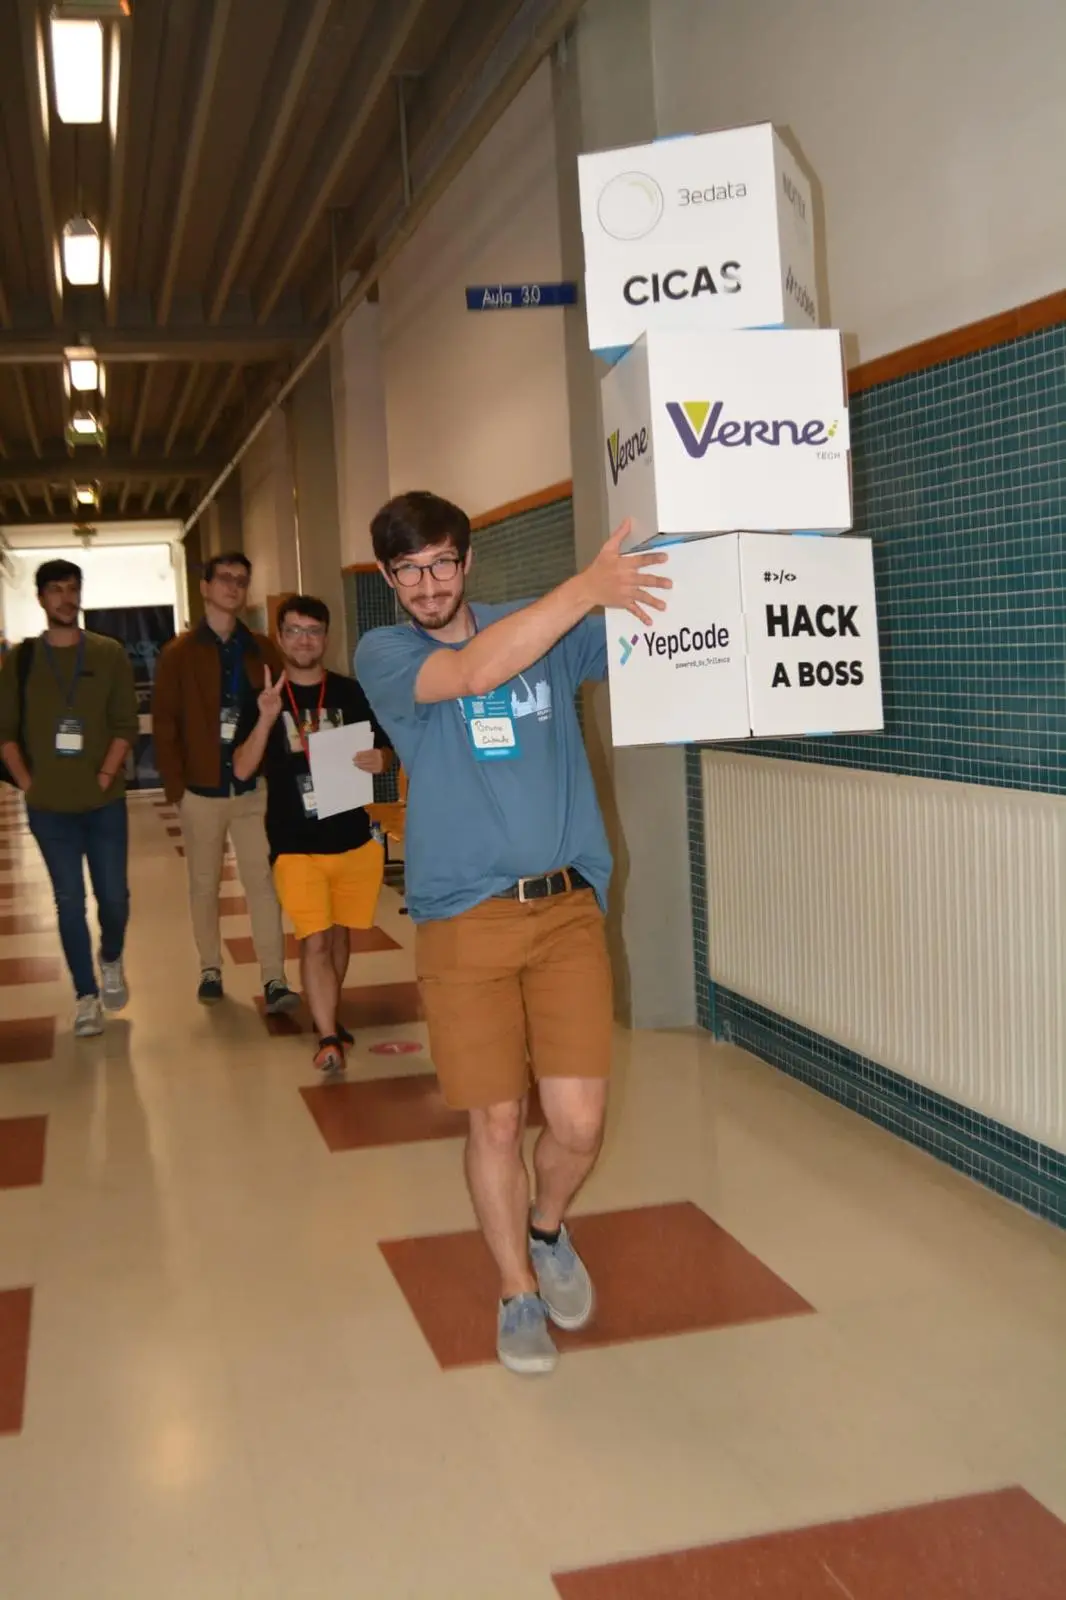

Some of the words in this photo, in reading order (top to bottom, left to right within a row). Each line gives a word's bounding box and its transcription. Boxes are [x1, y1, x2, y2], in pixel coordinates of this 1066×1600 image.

[678, 181, 747, 207] 3edata
[482, 284, 512, 309] Aula
[622, 260, 742, 306] CICAS
[665, 401, 829, 459] Verne
[607, 427, 648, 487] Verne
[765, 603, 861, 638] HACK
[643, 623, 730, 660] YepCode
[771, 661, 792, 688] A
[797, 660, 864, 687] BOSS
